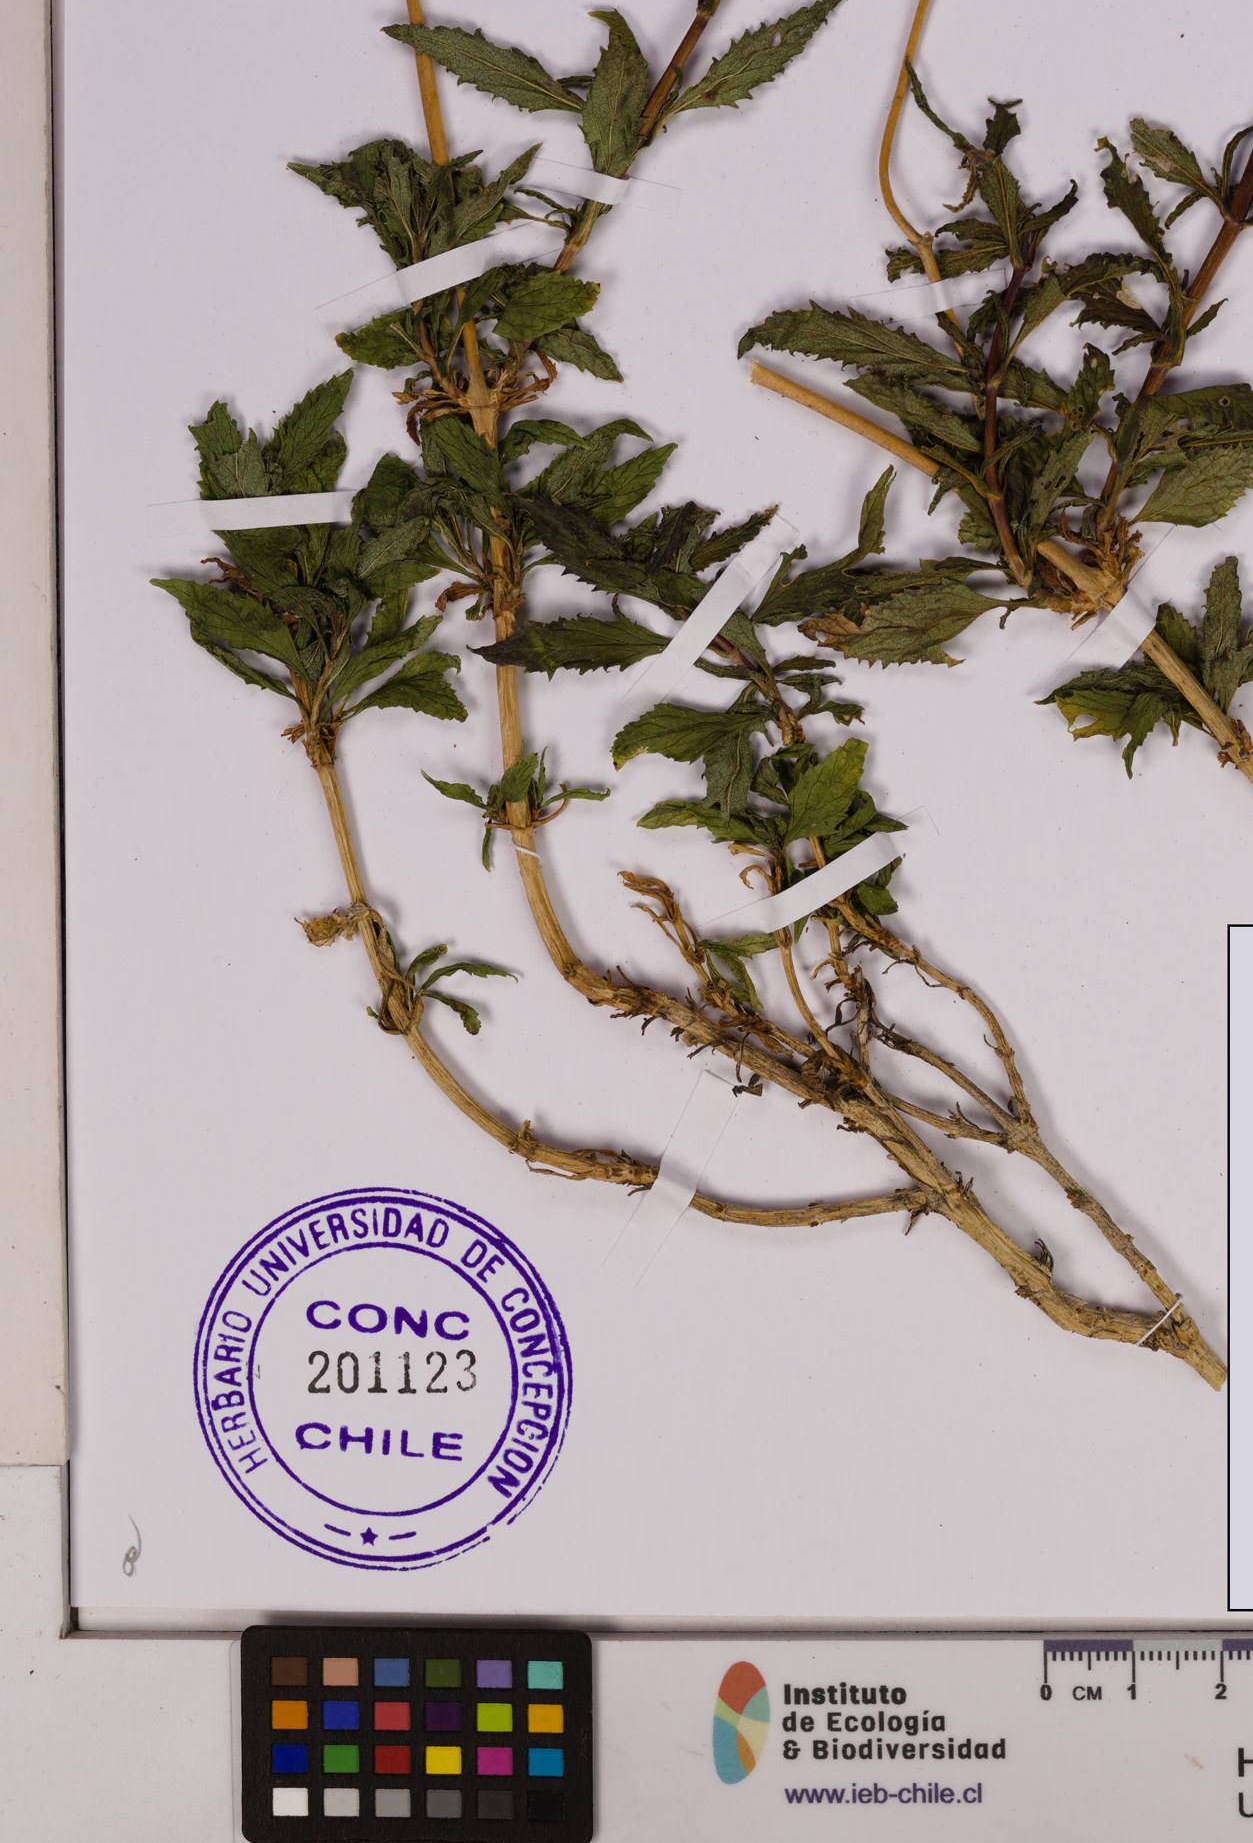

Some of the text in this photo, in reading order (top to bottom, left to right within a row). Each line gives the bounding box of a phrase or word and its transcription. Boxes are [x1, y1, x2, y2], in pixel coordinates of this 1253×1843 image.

[305, 1299, 471, 1341] CONC
[211, 1206, 555, 1500] HERBARIO UNIVERSIDAD DE CONCEPCION
[306, 1349, 479, 1395] 201123
[295, 1421, 464, 1462] CHILE
[783, 1681, 907, 1706] Instituto
[1039, 1684, 1053, 1701] 0
[1072, 1685, 1103, 1701] CM
[1127, 1683, 1137, 1701] 1
[1214, 1683, 1227, 1700] 2
[781, 1709, 946, 1737] de Ecología
[782, 1737, 1006, 1761] & Biodiversidad
[783, 1782, 983, 1805] www.ieb-chile.cl
